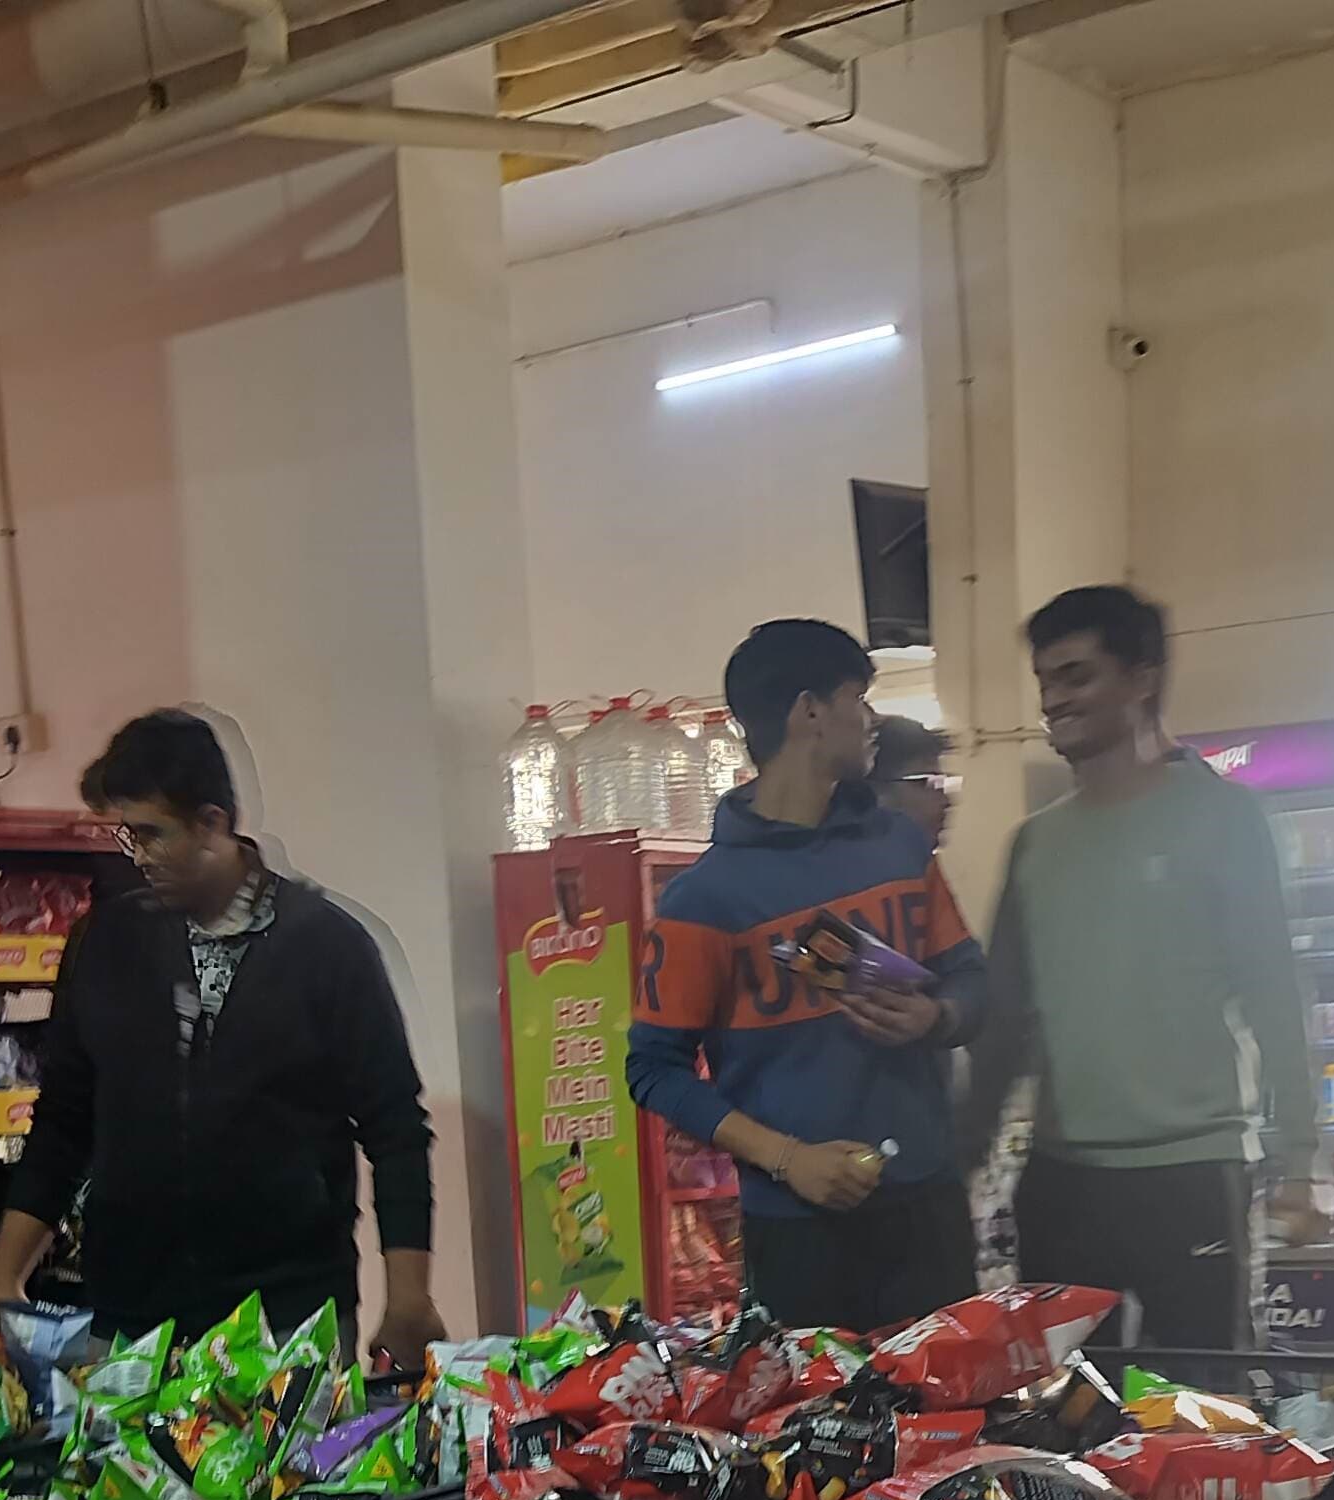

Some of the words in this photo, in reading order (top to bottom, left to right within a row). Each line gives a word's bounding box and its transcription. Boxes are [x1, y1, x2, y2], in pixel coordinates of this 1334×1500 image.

[553, 996, 604, 1032] Har
[552, 1033, 605, 1069] Bite
[545, 1070, 612, 1108] Mein
[542, 1106, 615, 1147] Masti
[1266, 1307, 1324, 1329] DA!
